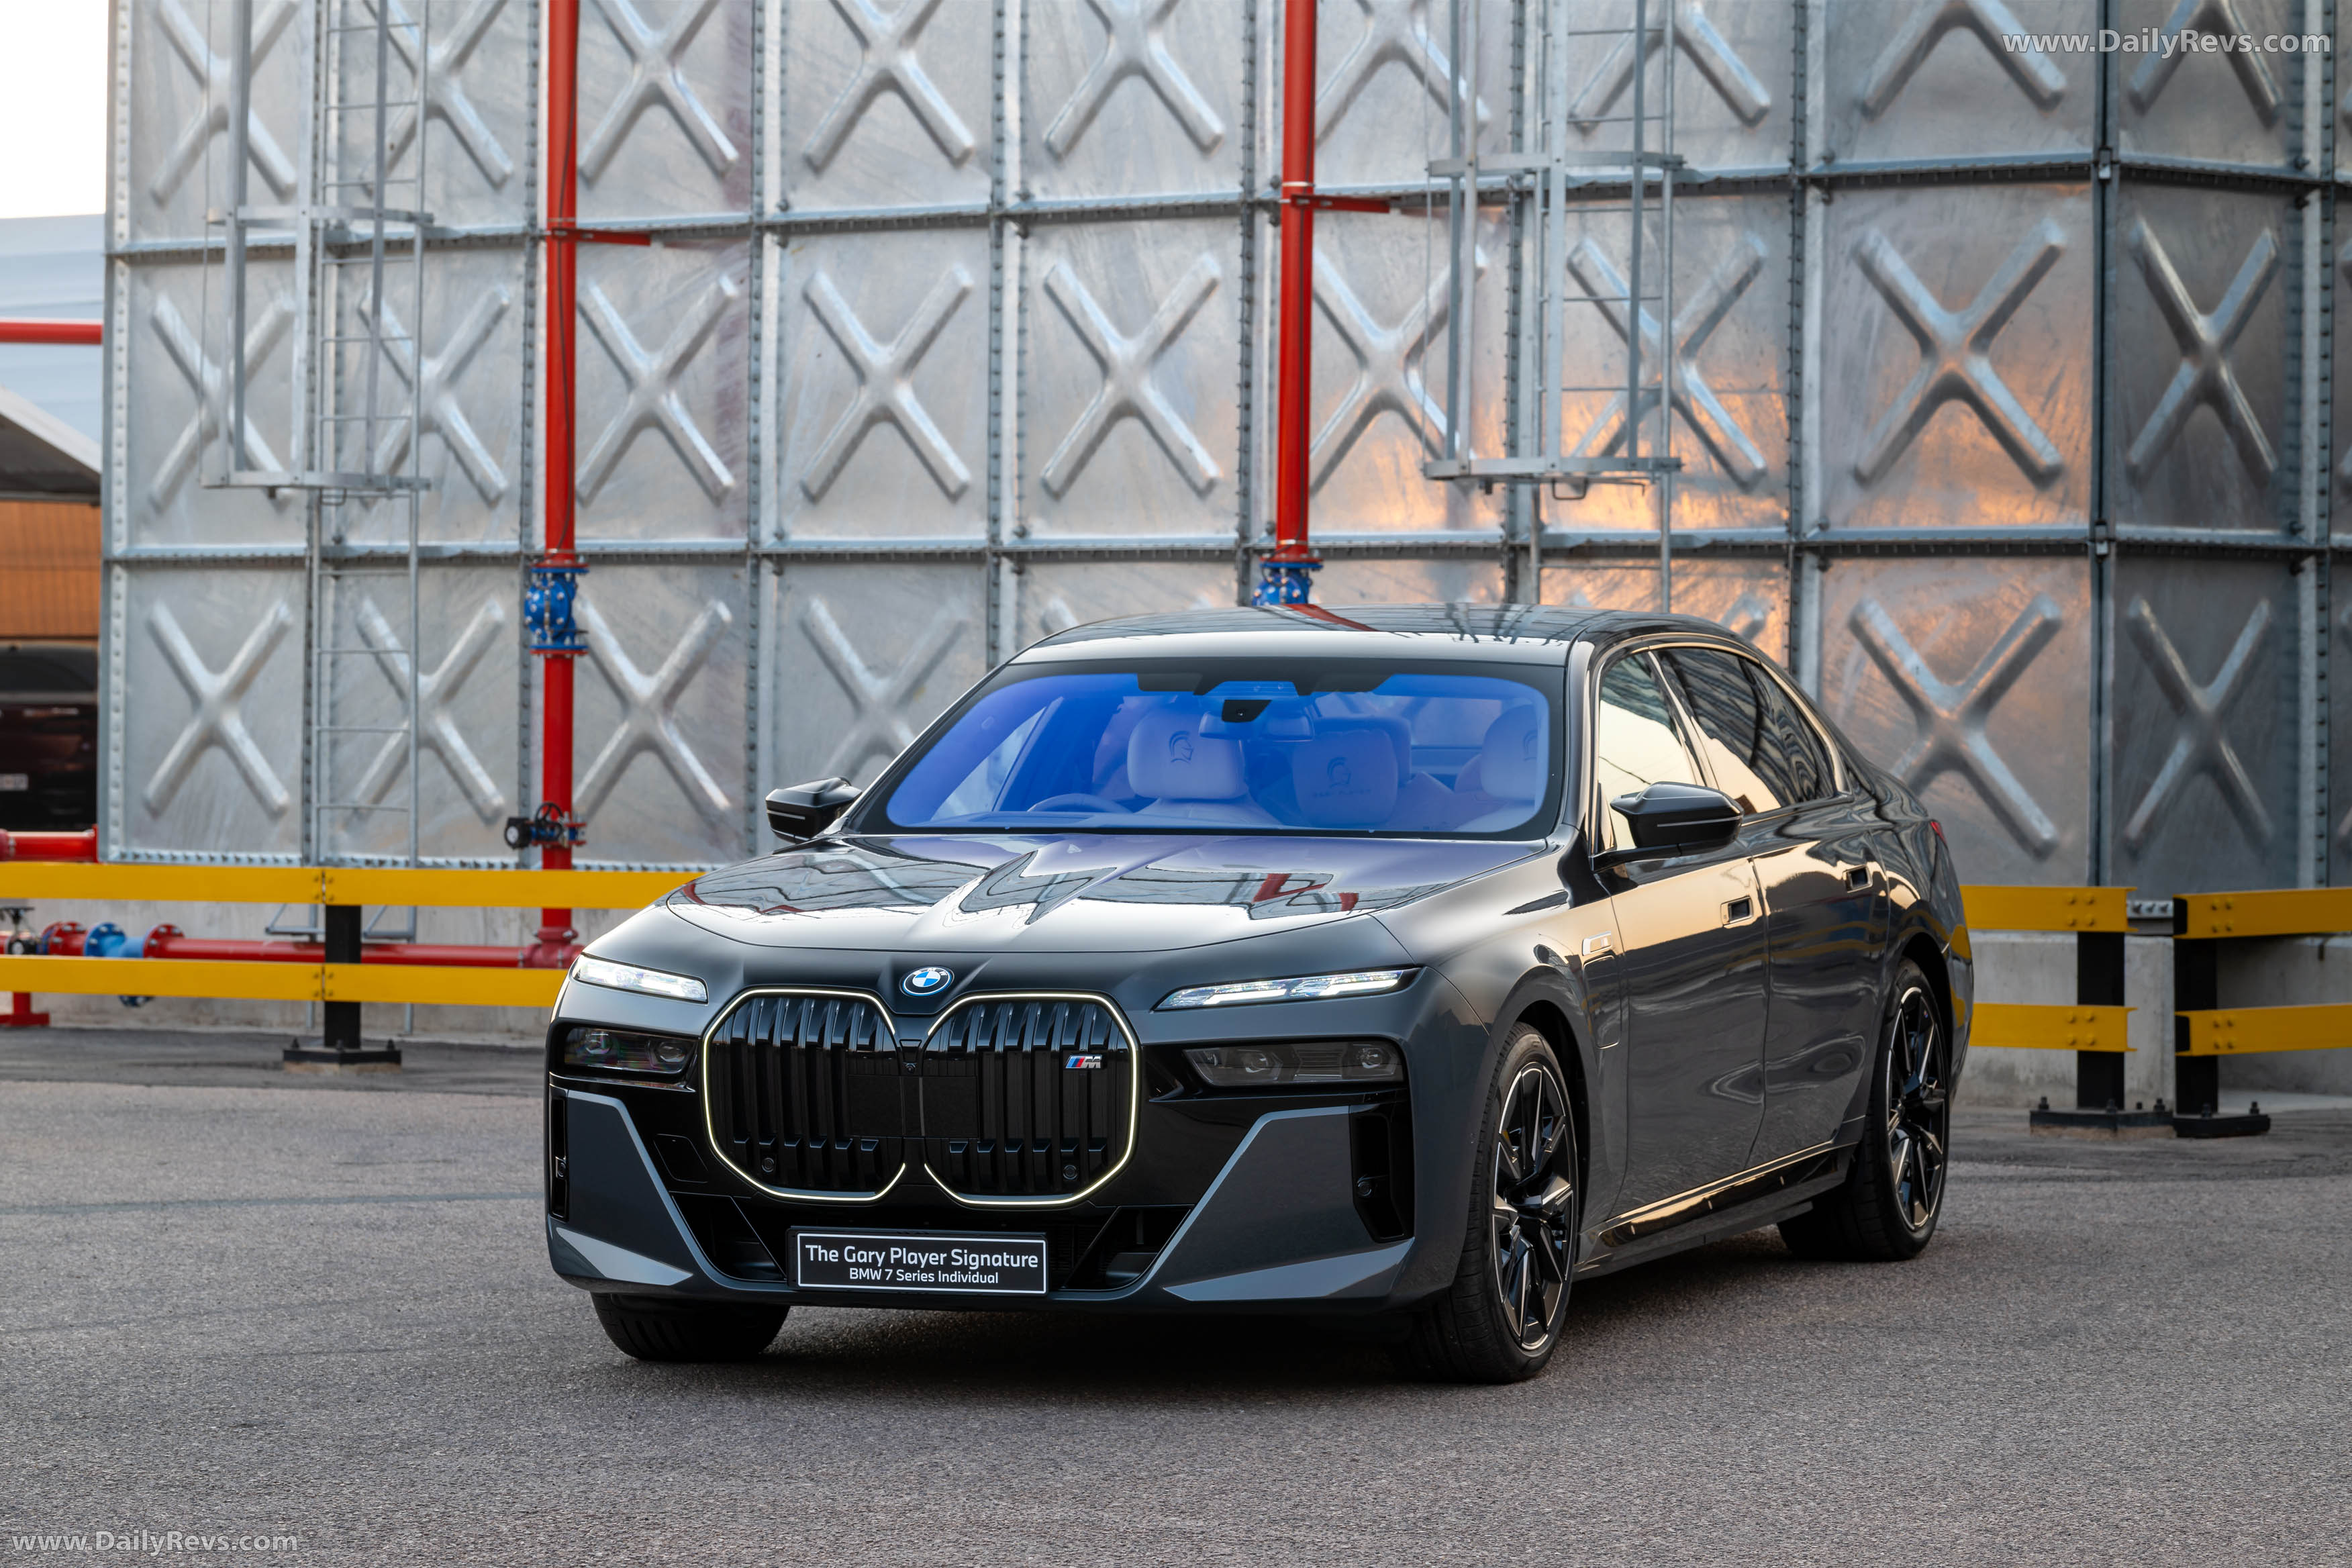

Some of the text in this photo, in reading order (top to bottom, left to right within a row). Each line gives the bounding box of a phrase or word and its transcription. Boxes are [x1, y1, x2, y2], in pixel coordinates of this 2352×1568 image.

[805, 1244, 1038, 1270] The Gary Player Signature
[849, 1267, 999, 1284] BMW 7 Series Individual
